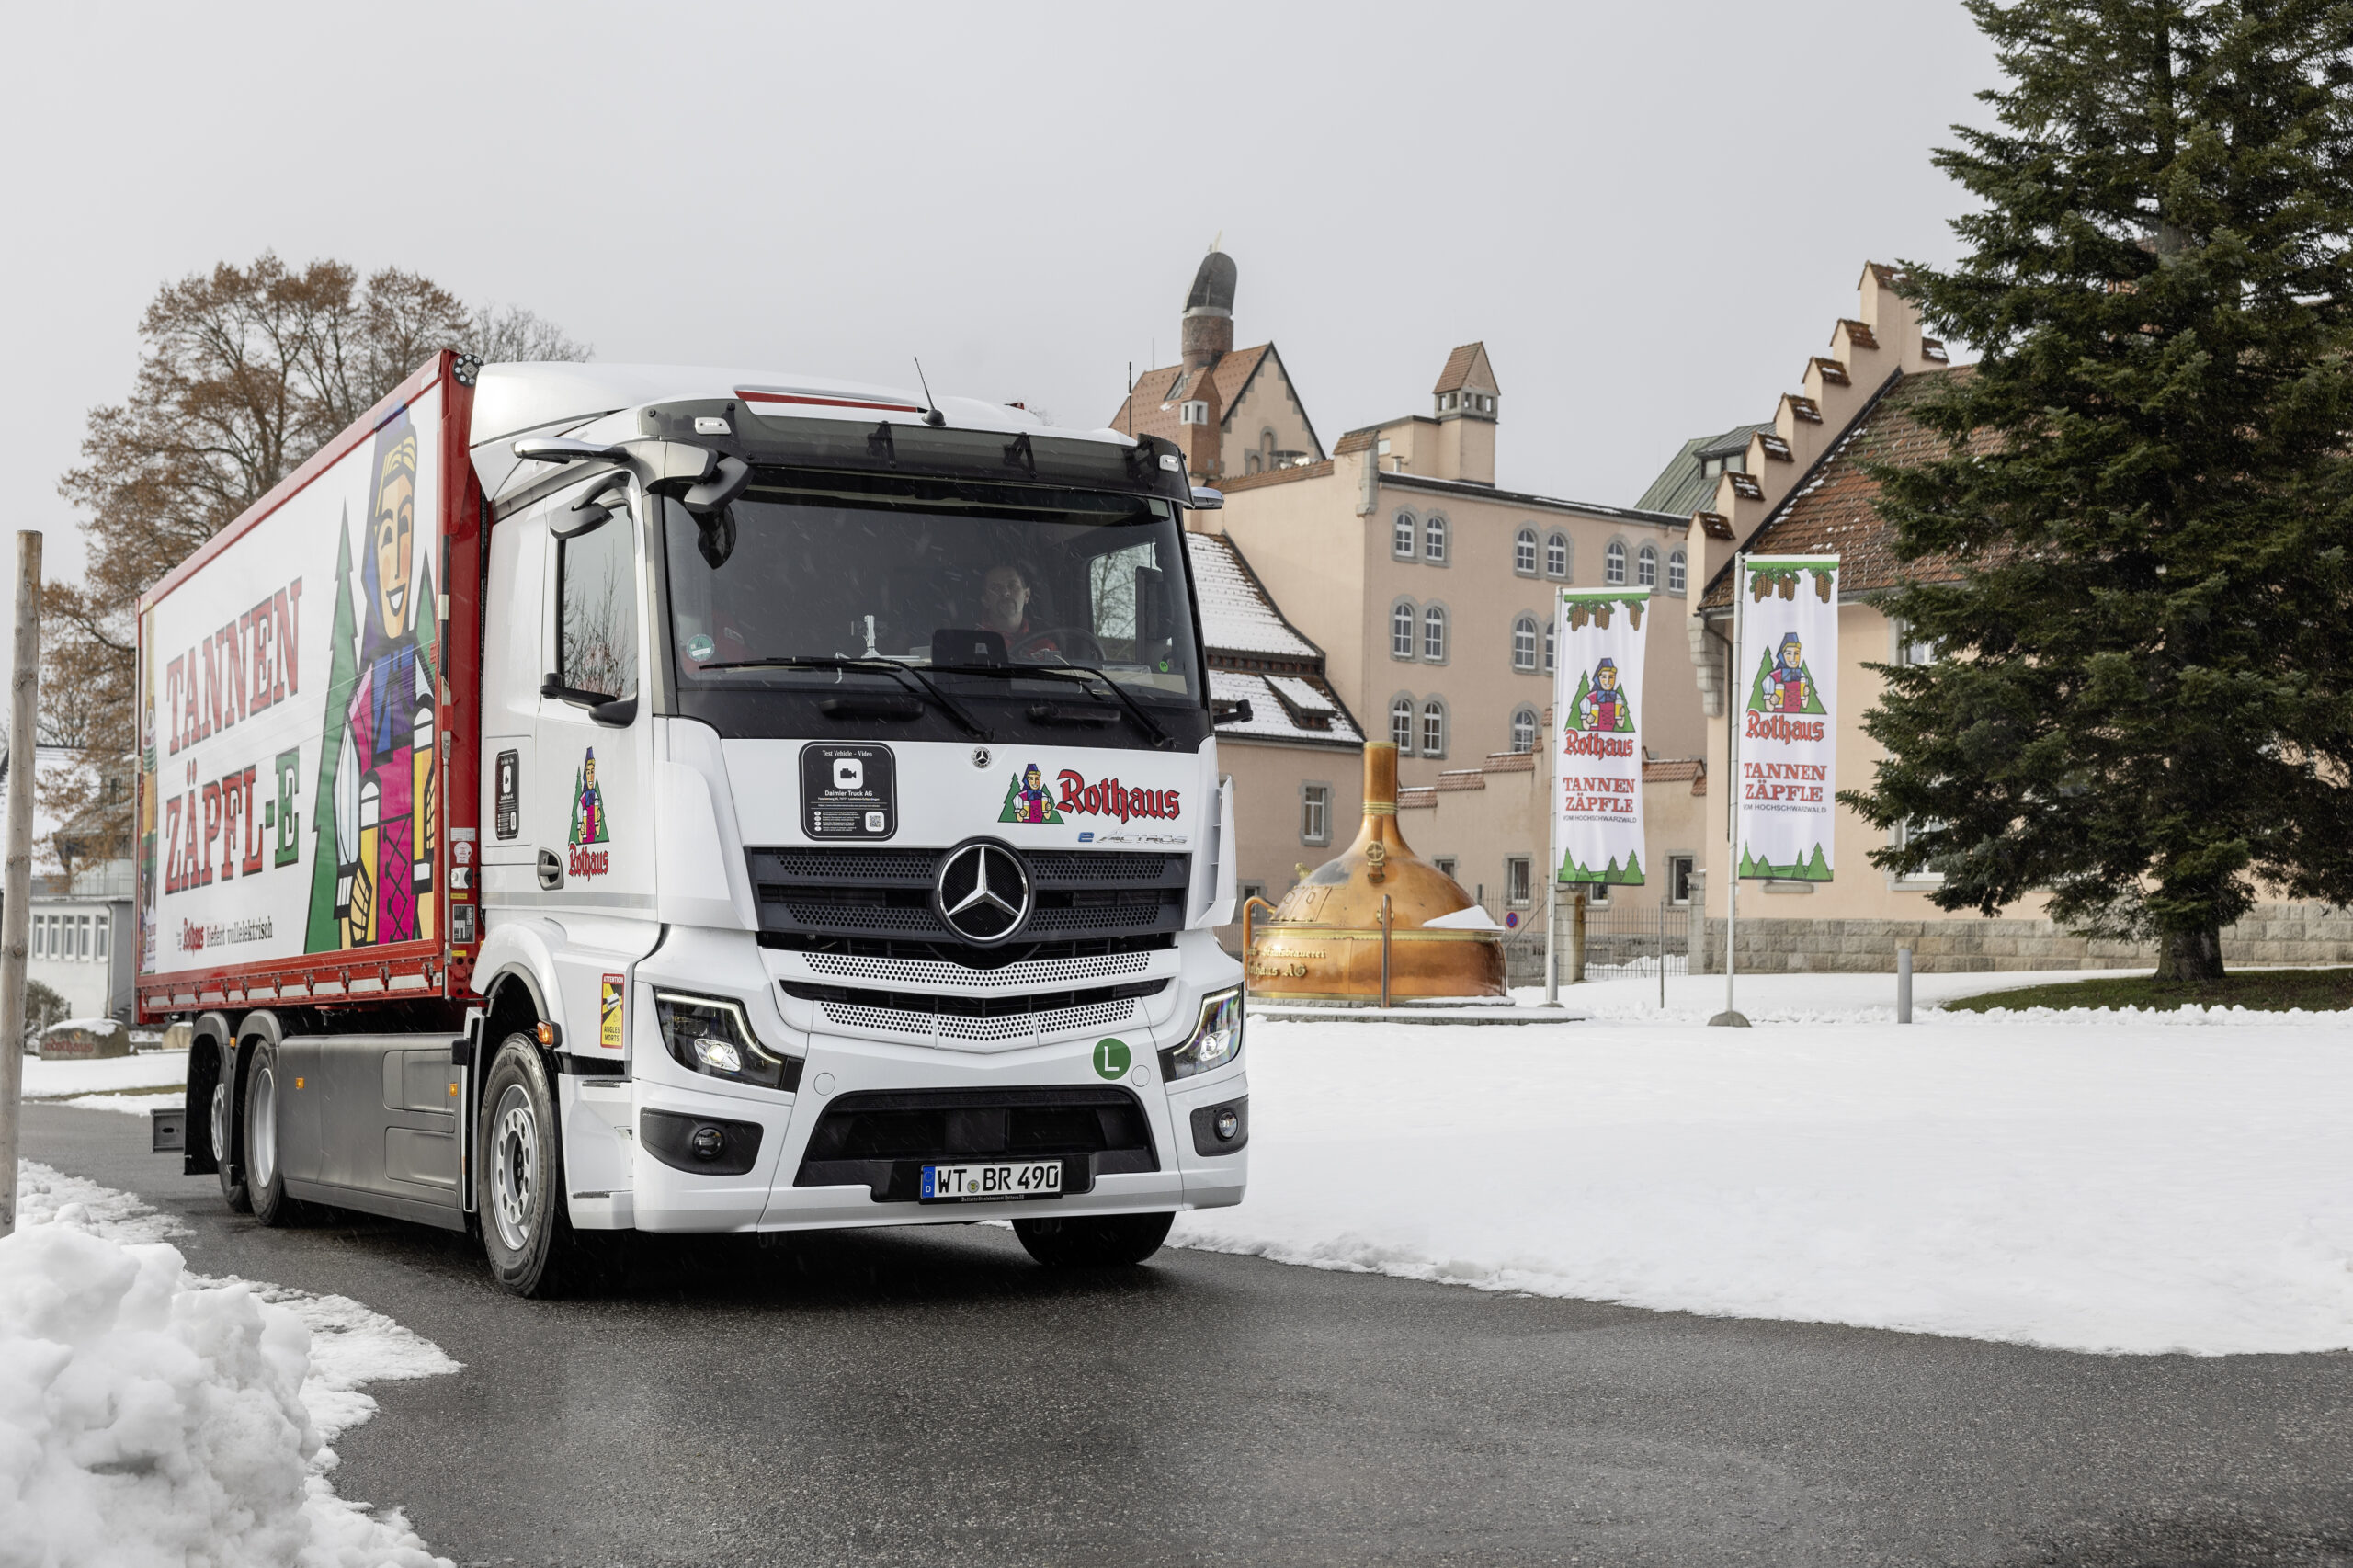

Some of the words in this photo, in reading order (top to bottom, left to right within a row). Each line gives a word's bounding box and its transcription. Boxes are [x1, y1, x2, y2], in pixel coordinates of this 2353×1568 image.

[166, 575, 302, 757] TANNEN
[1745, 710, 1825, 745] Rothaus
[1563, 729, 1634, 761] Rothaus
[1744, 762, 1827, 781] TANNEN
[1055, 768, 1181, 825] Rothaus
[1563, 777, 1636, 794] TANNEN
[1745, 779, 1824, 802] ZÄPFLE
[1565, 792, 1633, 813] ZÄPFLE
[1754, 803, 1827, 813] HOCHSCHWARZWALD
[165, 745, 300, 896] ZÄPFL-E
[1574, 815, 1637, 824] HOCHSCHWARZWALD
[568, 843, 609, 882] Rothaus
[206, 923, 226, 948] liefert
[227, 915, 273, 945] vollelektrisch
[1281, 963, 1308, 978] AG
[604, 1026, 620, 1034] ANGLES
[604, 1034, 620, 1042] MORTS
[1104, 1046, 1120, 1072] L
[938, 1168, 967, 1193] WT
[983, 1167, 1011, 1191] BR
[1017, 1165, 1059, 1189] 490
